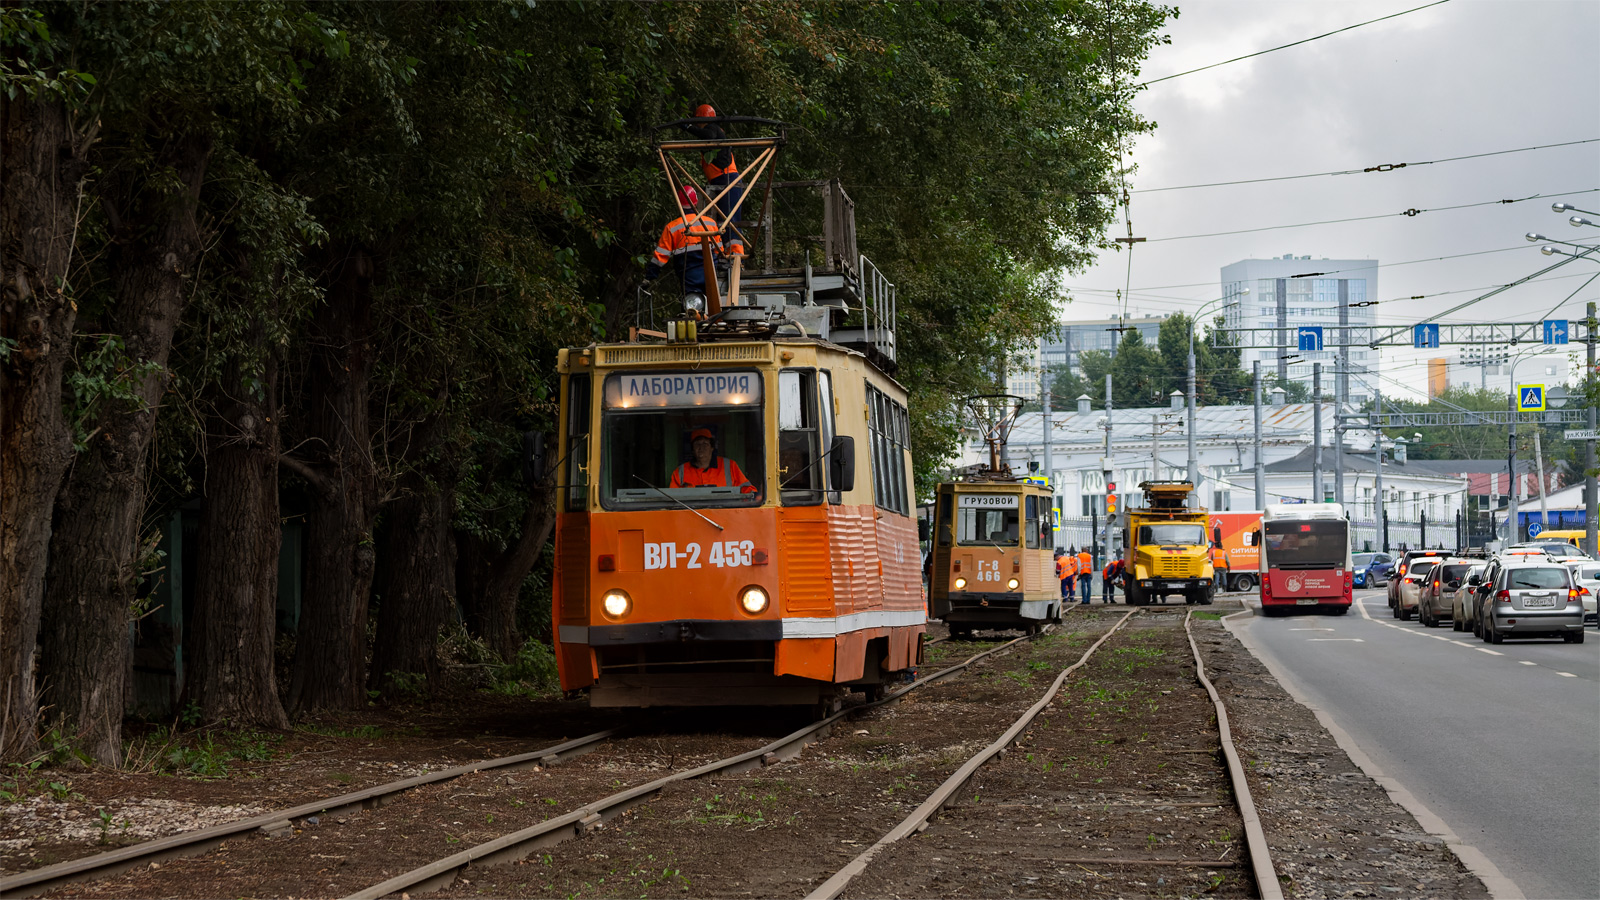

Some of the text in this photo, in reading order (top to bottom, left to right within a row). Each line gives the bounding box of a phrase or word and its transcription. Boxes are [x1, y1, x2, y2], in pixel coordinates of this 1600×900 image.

[629, 375, 749, 396] ЛАБОРАТОРИЯ
[964, 496, 1013, 505] ГРУЗОВОЙ
[644, 540, 755, 570] ВЛ-2 453
[978, 560, 999, 571] Г-8
[976, 571, 1001, 582] 466
